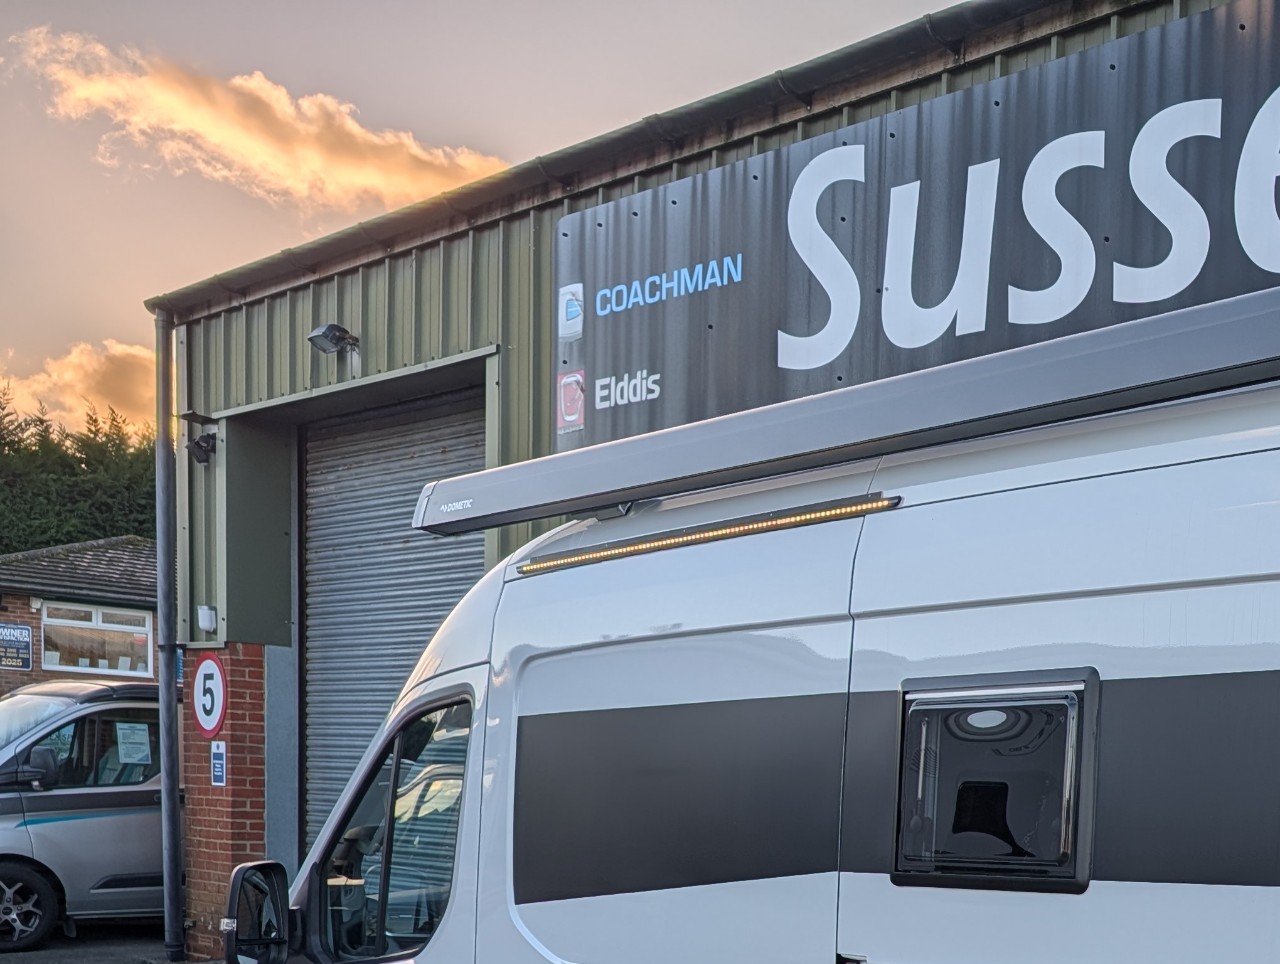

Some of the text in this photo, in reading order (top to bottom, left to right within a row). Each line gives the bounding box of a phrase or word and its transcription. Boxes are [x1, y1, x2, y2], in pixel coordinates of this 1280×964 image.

[595, 253, 743, 317] COACHMAN
[594, 369, 661, 410] Elddis
[446, 499, 473, 512] DOMETIC
[0, 628, 29, 638] WNER
[202, 672, 215, 717] 5
